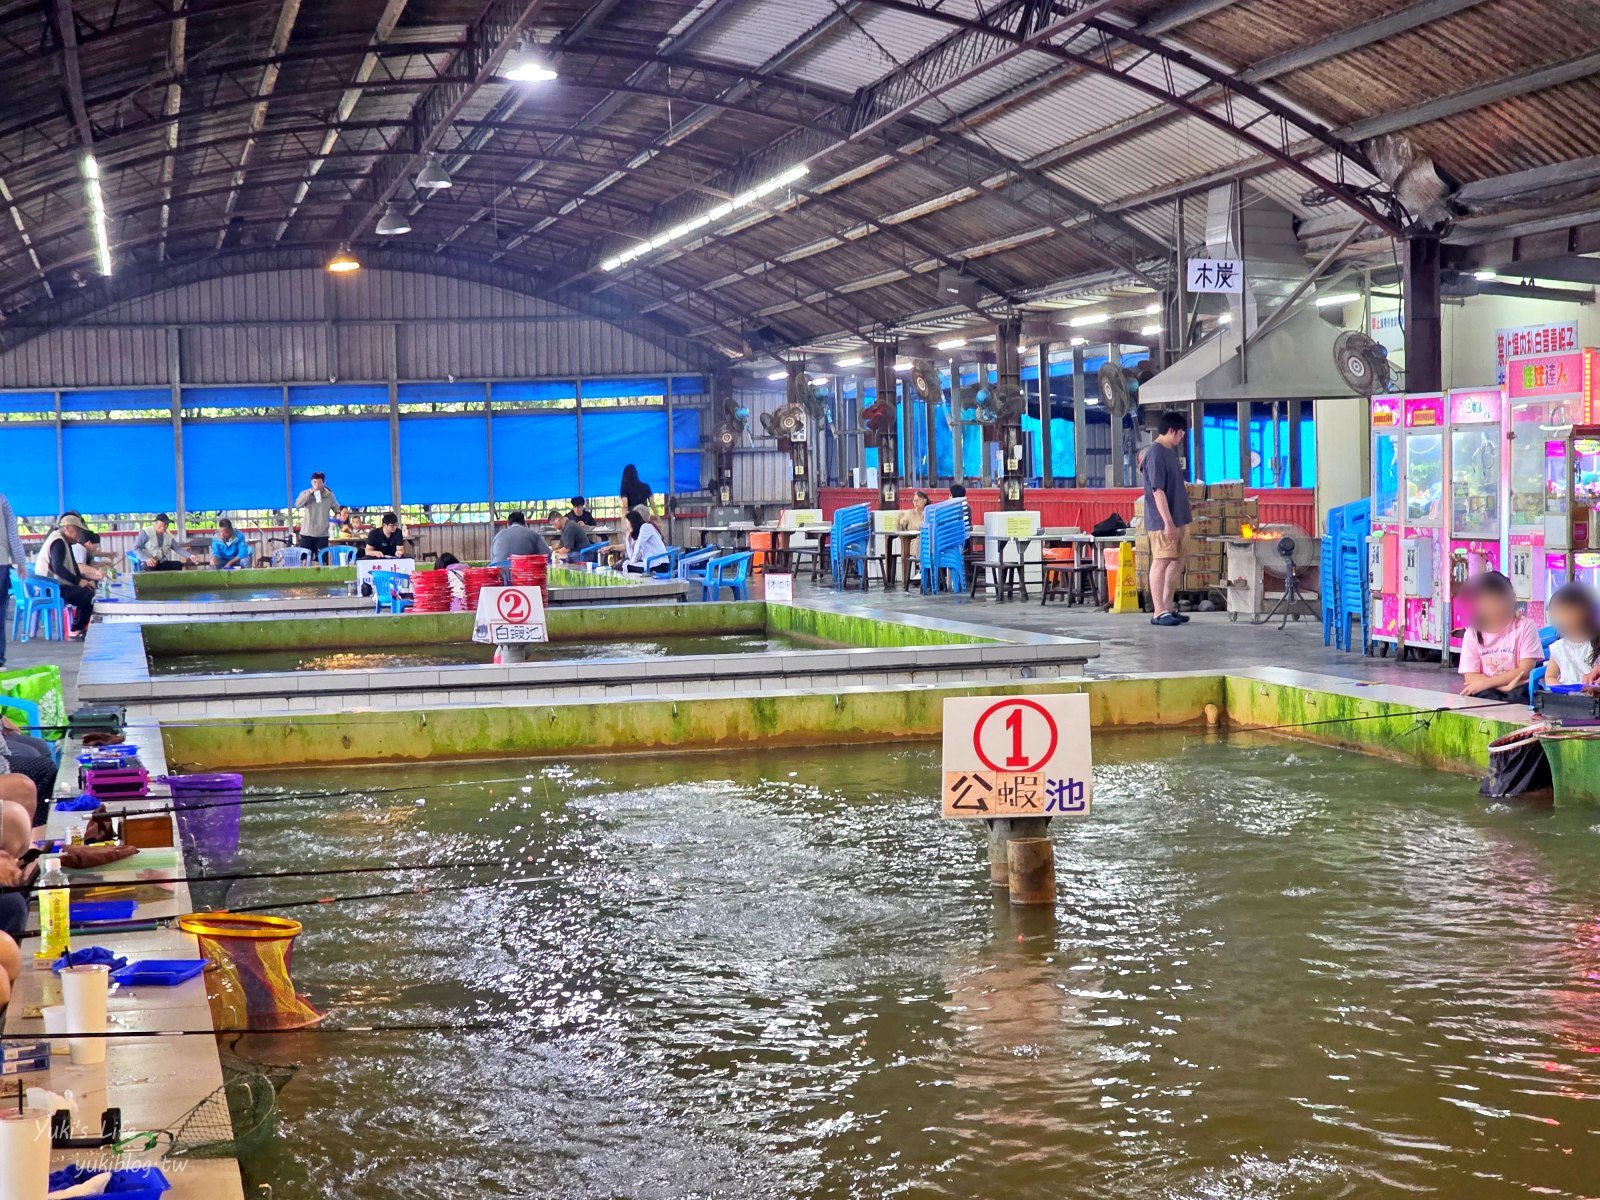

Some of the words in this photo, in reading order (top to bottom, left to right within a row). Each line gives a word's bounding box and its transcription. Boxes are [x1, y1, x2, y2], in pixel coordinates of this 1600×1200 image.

[1195, 262, 1234, 289] 木炭
[950, 773, 1086, 813] 公蝦池
